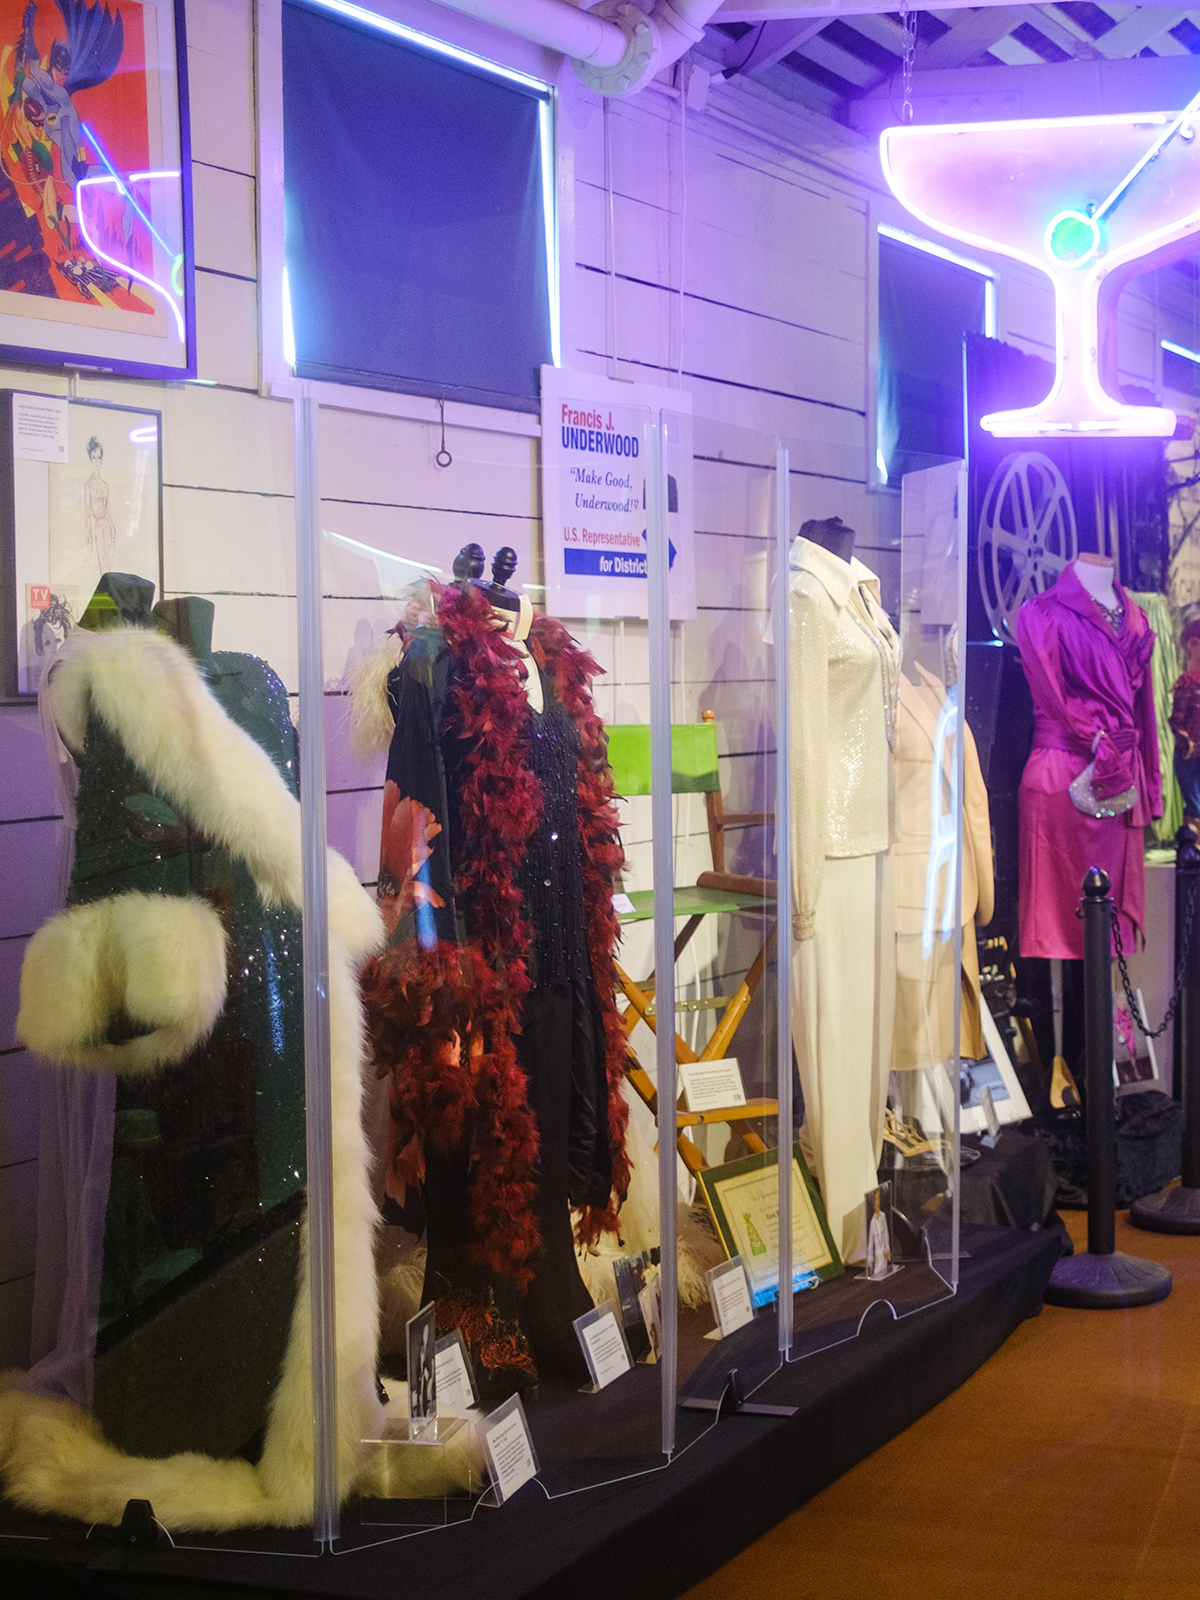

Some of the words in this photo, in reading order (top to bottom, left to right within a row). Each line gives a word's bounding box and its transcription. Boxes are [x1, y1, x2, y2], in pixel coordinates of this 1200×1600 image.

[561, 403, 602, 430] Francis
[606, 412, 615, 431] J.
[561, 425, 639, 458] UNDERWOOD
[570, 467, 602, 486] “Make
[605, 471, 633, 491] Good,
[563, 526, 580, 543] U.S.
[582, 528, 641, 547] Representative
[599, 555, 612, 572] for
[614, 556, 648, 575] District
[33, 588, 49, 600] TV
